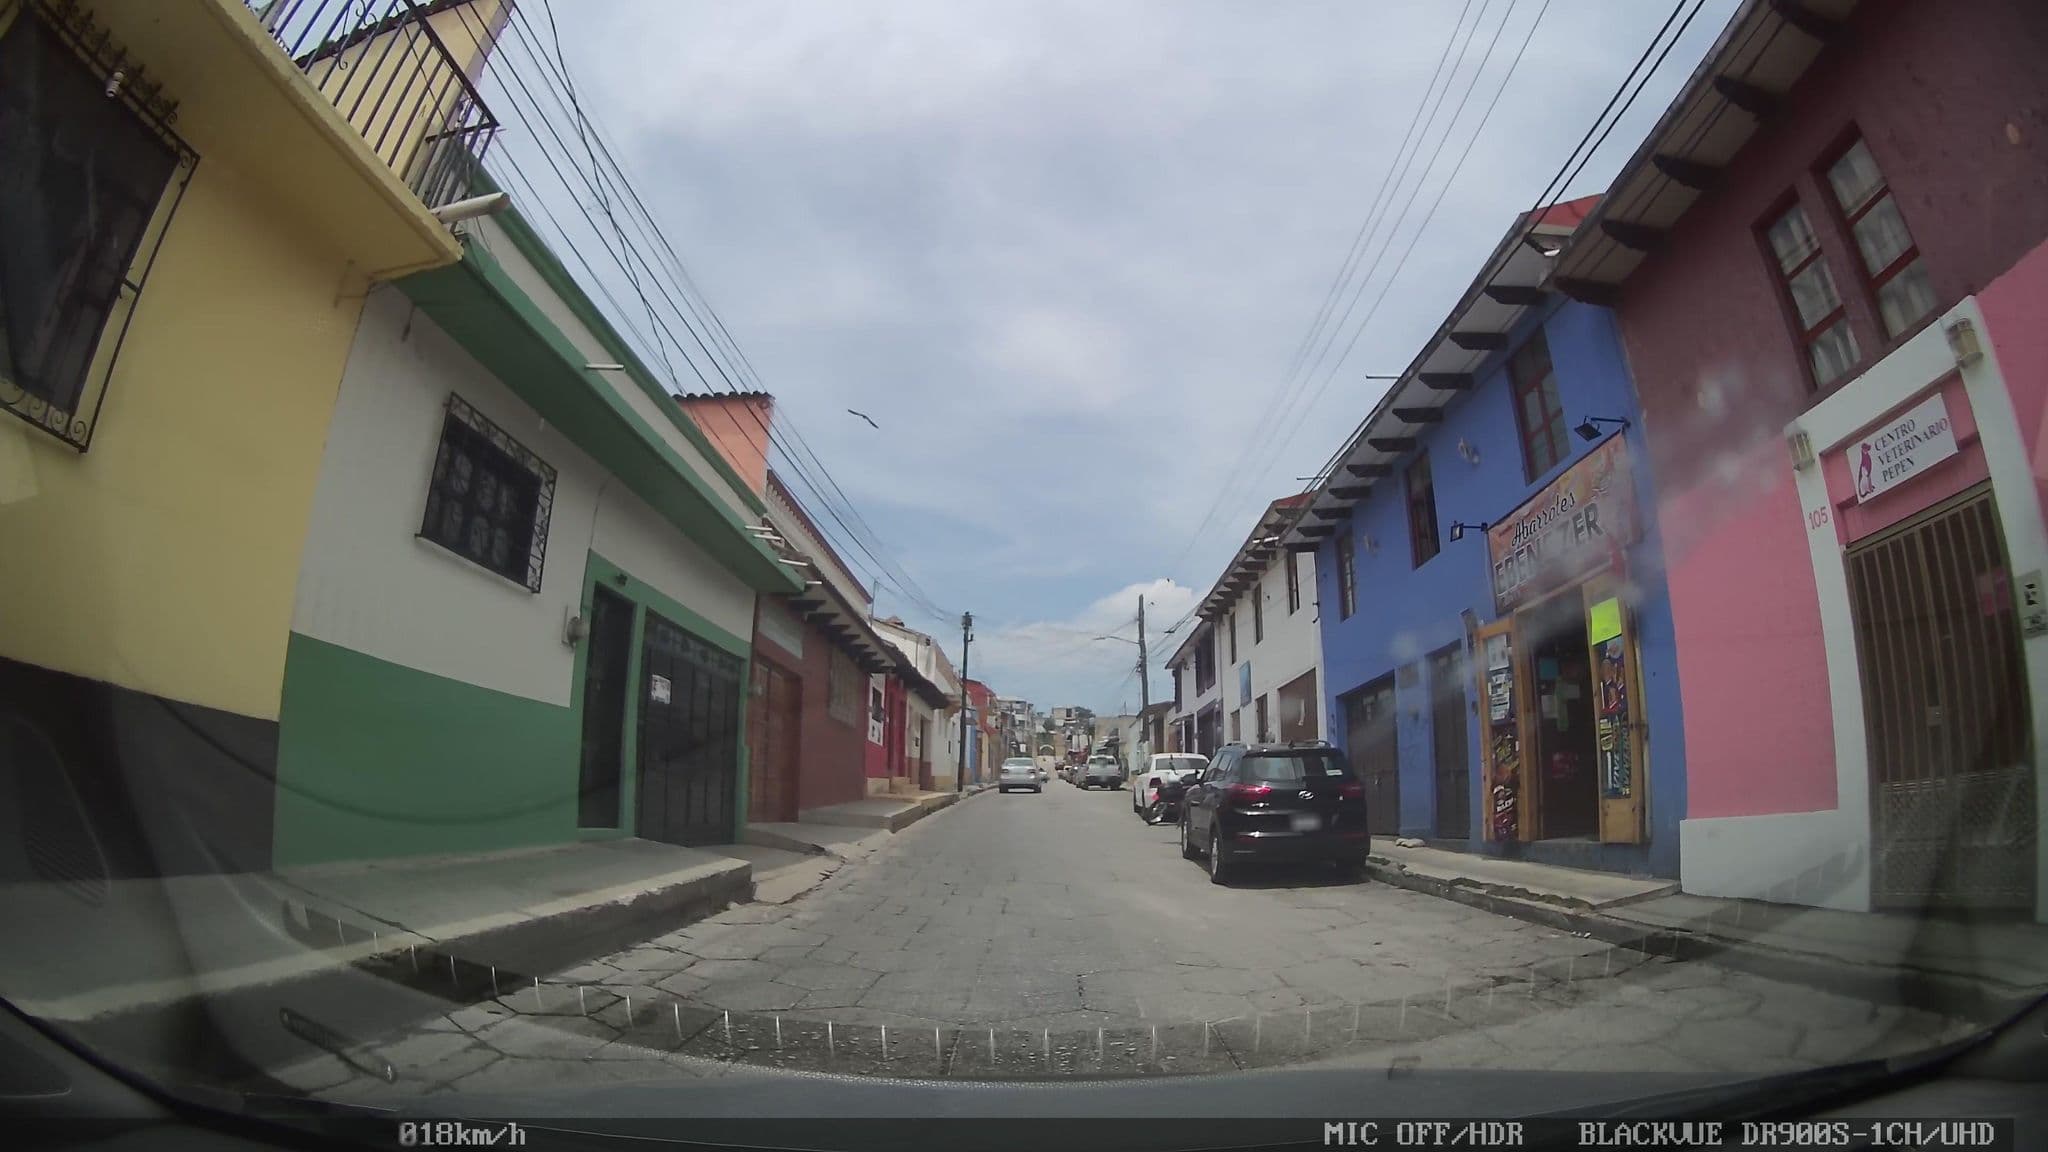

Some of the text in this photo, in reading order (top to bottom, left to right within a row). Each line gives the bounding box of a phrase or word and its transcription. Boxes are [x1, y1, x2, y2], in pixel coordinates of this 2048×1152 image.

[1874, 419, 1915, 451] CENTRO
[1878, 417, 1948, 465] VETERINARIO
[1882, 457, 1914, 482] PEPEN
[1511, 491, 1576, 547] Abarrotes
[1808, 506, 1829, 530] 105
[1495, 502, 1604, 593] EBENZER
